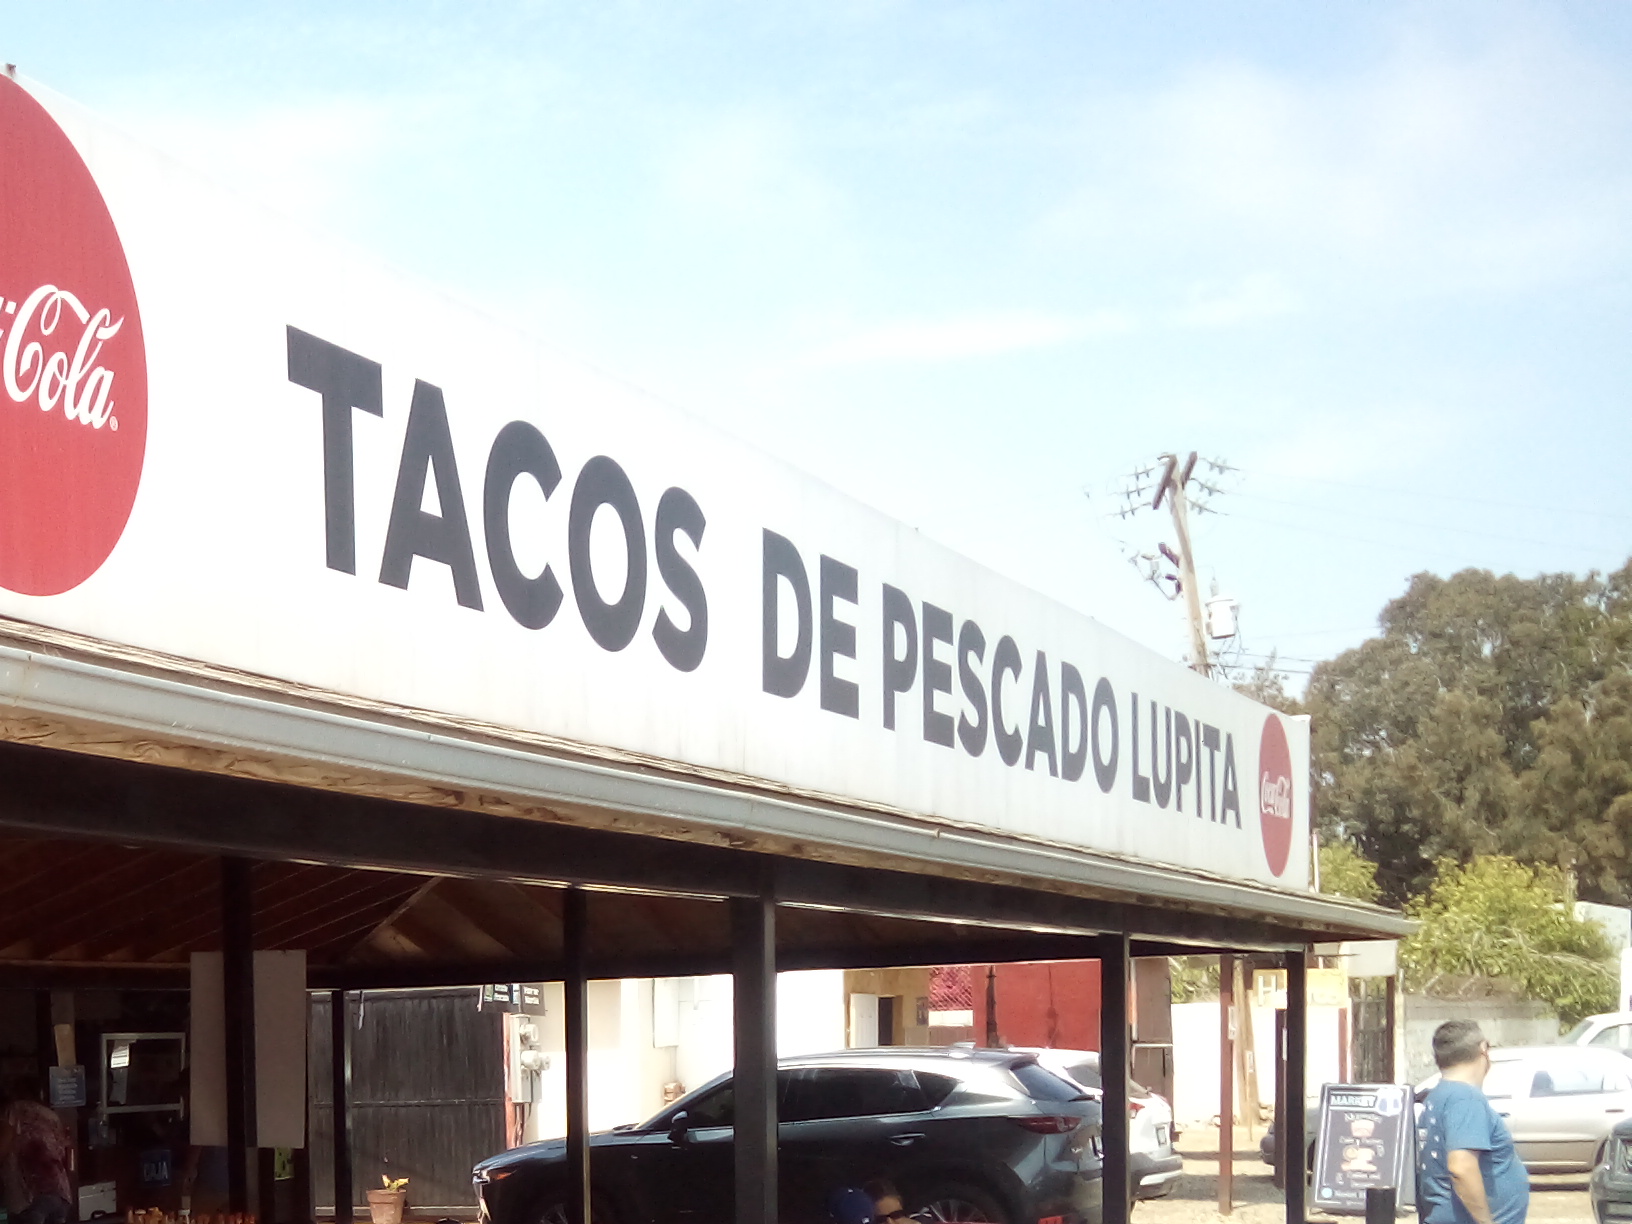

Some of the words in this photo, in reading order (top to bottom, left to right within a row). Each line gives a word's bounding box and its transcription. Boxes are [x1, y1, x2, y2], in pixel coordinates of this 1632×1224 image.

[286, 324, 708, 674] TACOS
[761, 525, 860, 715] DE
[881, 581, 1120, 795] PESCADO
[1129, 697, 1243, 831] LUPITA
[1330, 1094, 1377, 1107] MARKET
